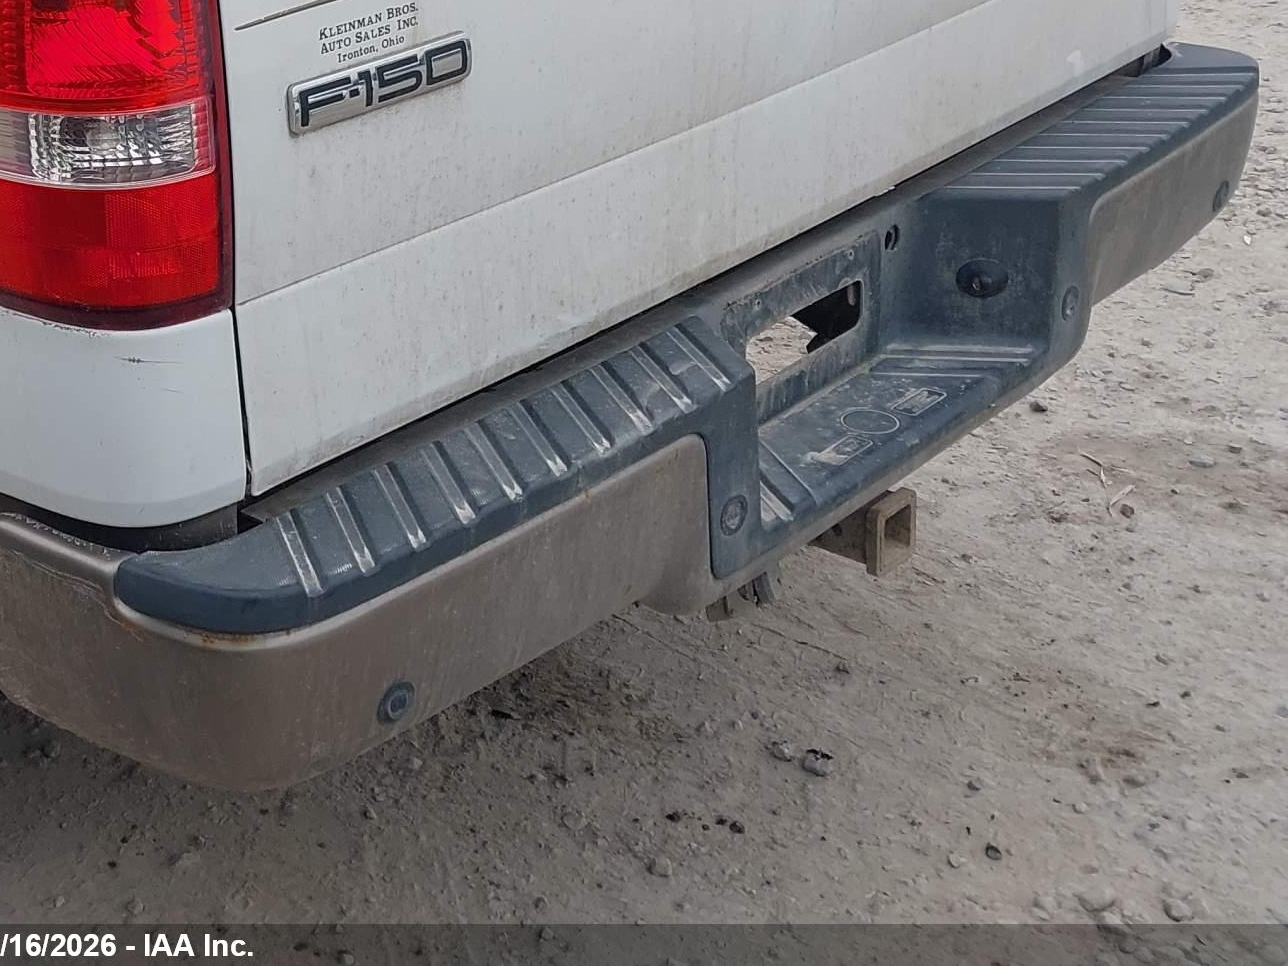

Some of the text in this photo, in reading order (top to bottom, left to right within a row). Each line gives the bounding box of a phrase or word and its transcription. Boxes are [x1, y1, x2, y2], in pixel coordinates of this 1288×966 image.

[319, 2, 419, 41] KLEINMAN BROS.
[320, 37, 352, 55] AUTO
[355, 24, 391, 44] SALES
[337, 35, 405, 63] Ironton, Ohio
[299, 40, 469, 128] F-150
